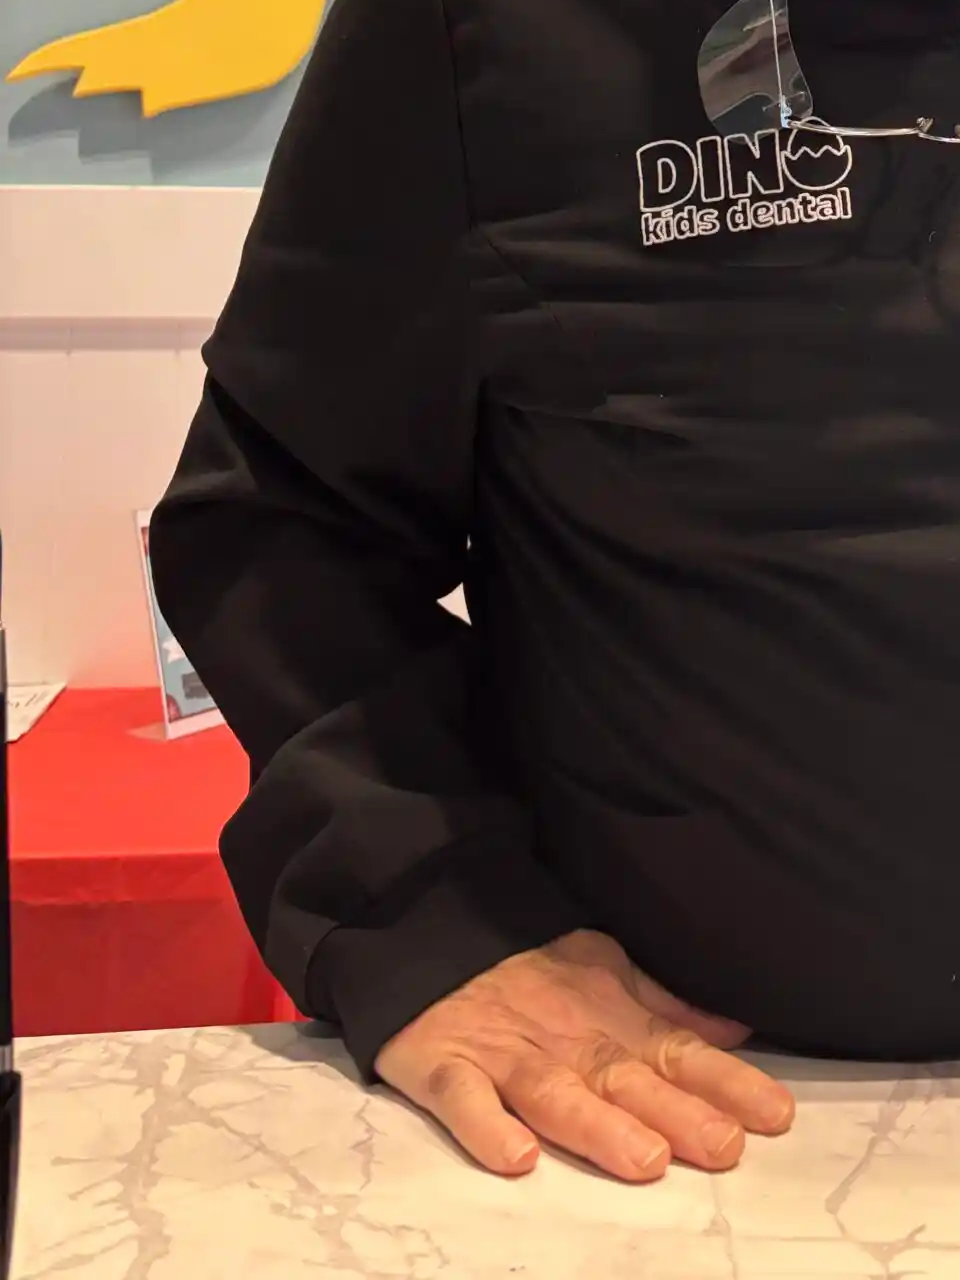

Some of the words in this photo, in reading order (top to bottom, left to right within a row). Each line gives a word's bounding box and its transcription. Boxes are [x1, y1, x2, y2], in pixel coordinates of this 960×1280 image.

[636, 116, 852, 212] DINO
[641, 205, 720, 245] kids
[727, 187, 852, 232] dental
